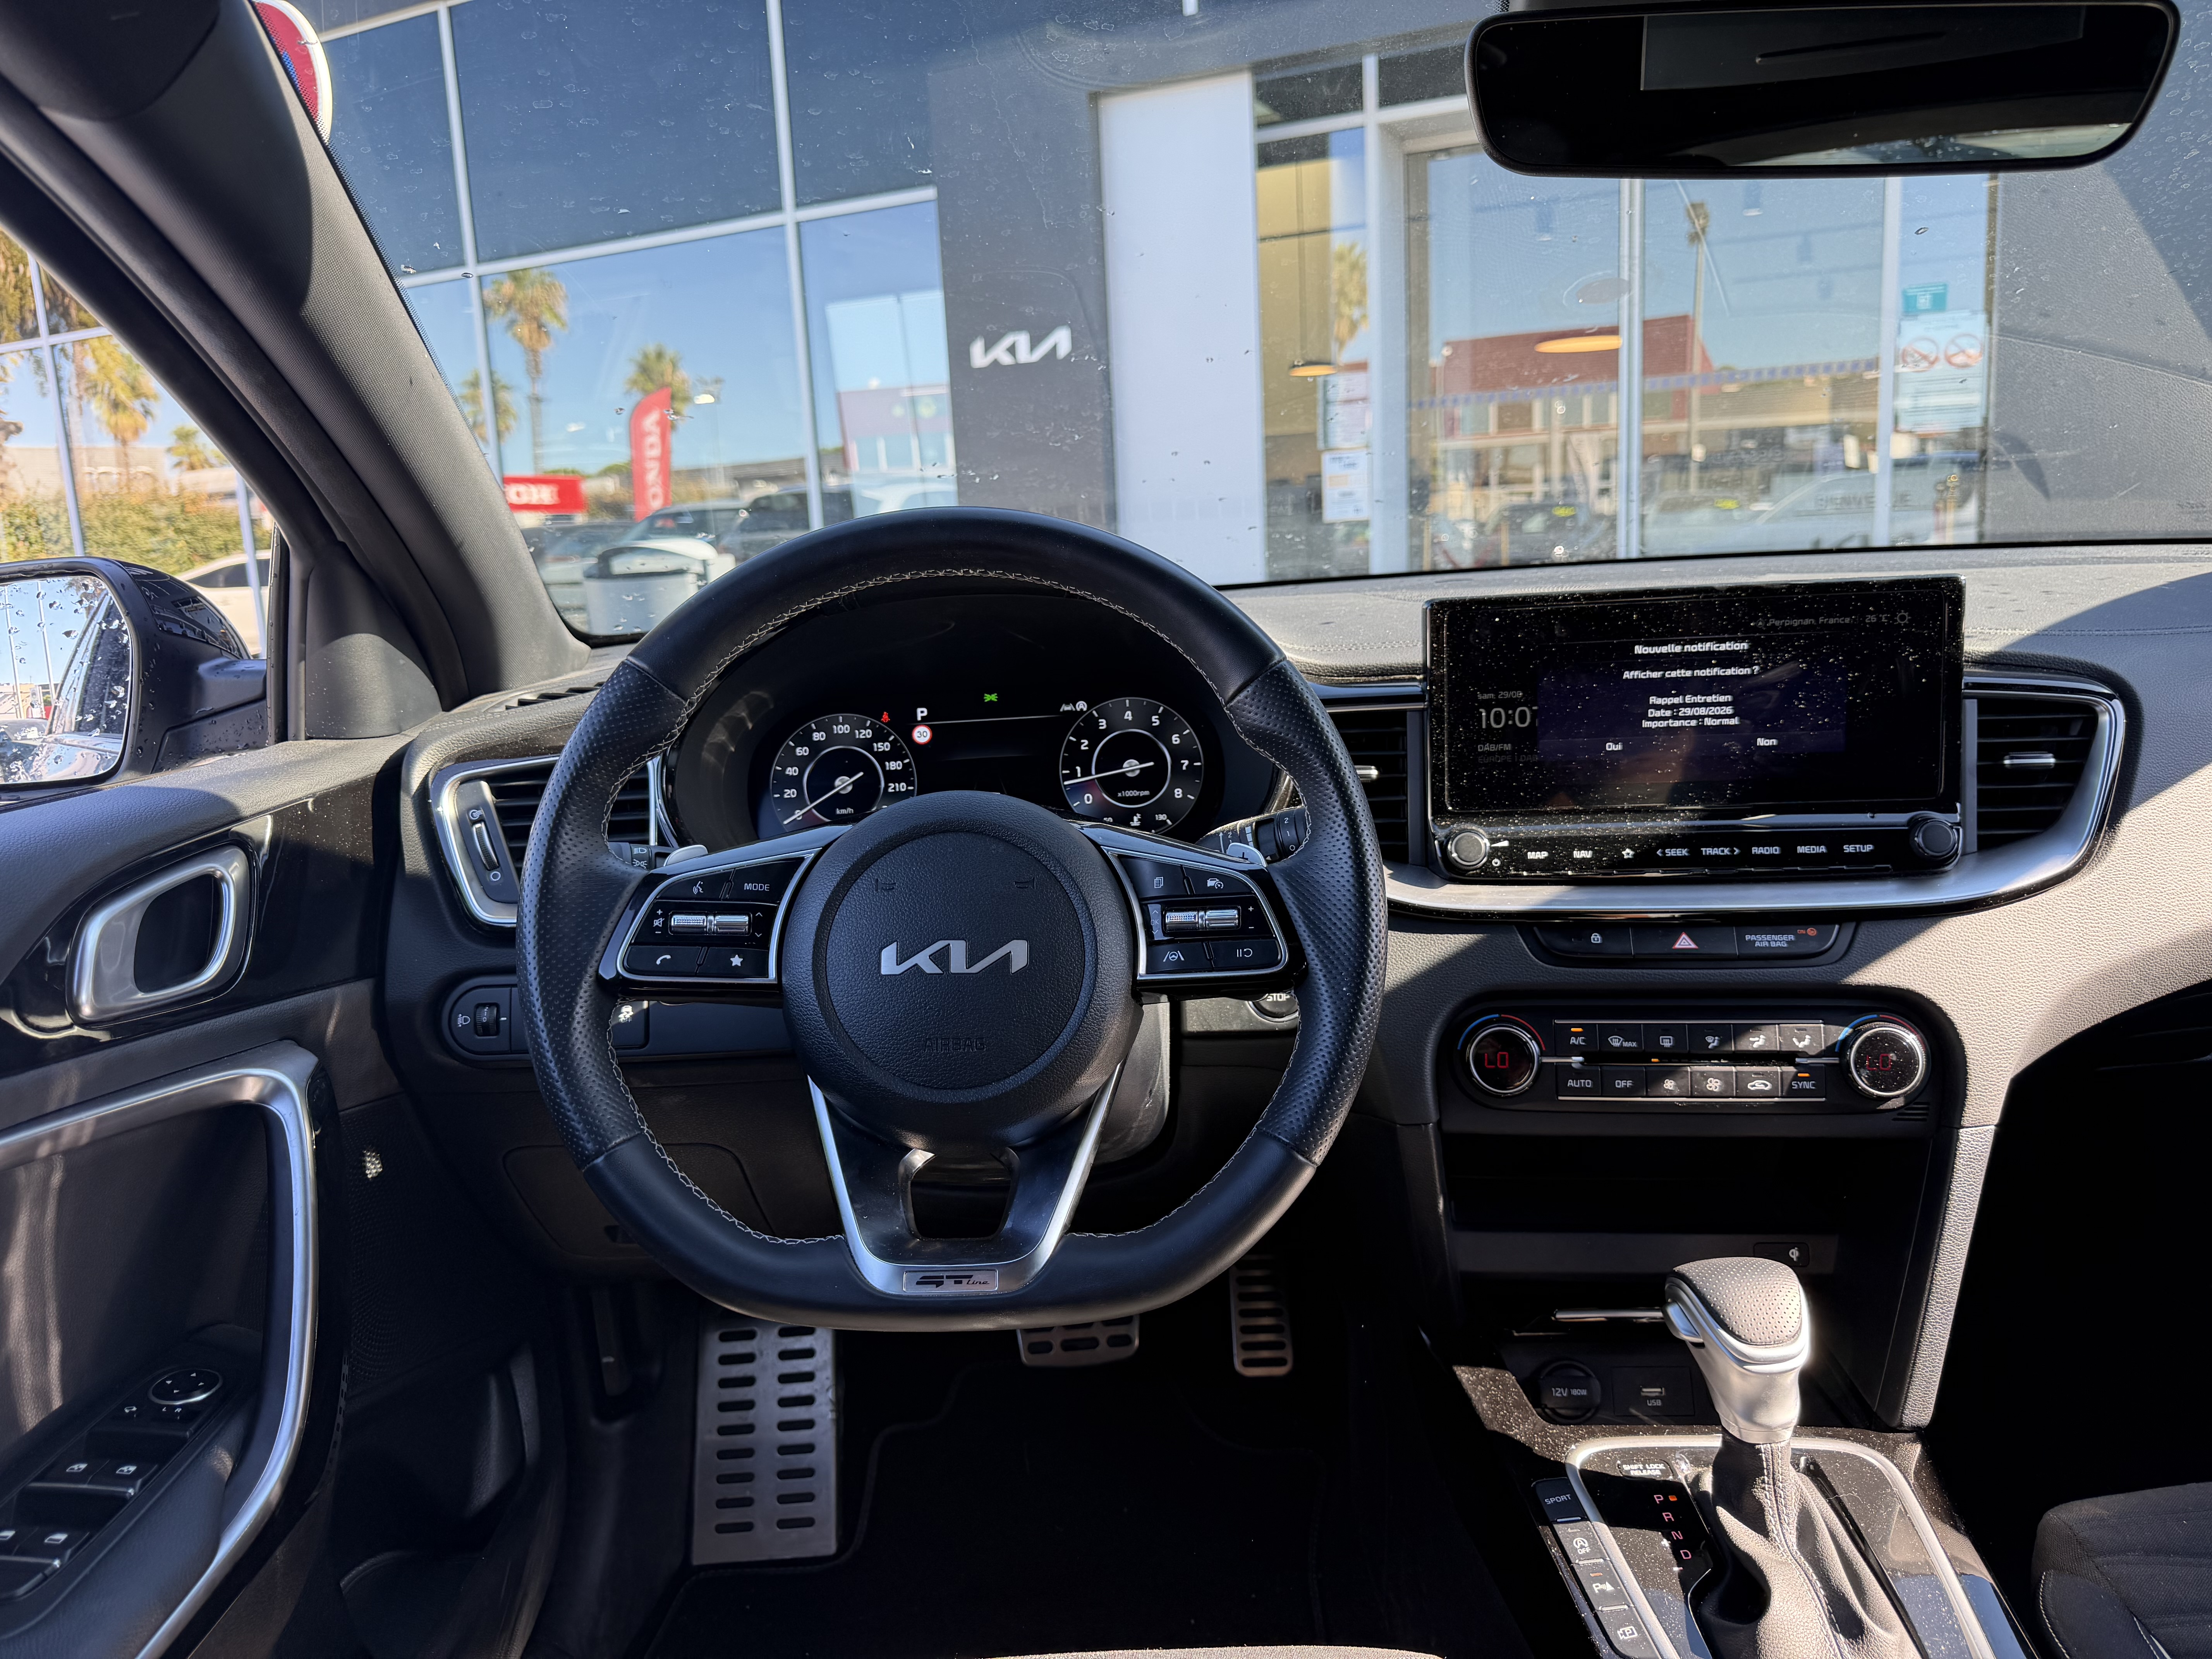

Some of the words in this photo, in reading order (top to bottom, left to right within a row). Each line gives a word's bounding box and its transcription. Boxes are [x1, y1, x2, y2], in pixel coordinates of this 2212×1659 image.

[970, 325, 1072, 368] KIA
[1635, 644, 1683, 654] Nouvelle
[1684, 641, 1750, 652] notification
[1623, 670, 1664, 679] Afficher
[1665, 668, 1693, 678] cette
[1694, 666, 1752, 677] notification
[1649, 696, 1684, 705] Rappel
[1685, 694, 1734, 704] Entretien
[916, 708, 928, 721] P
[1124, 711, 1133, 721] 4
[1648, 709, 1673, 717] Date
[1679, 706, 1735, 716] 29/08/2026
[1098, 719, 1107, 729] 3
[1151, 716, 1160, 726] 5
[1642, 719, 1698, 728] Importance
[1704, 716, 1741, 725] Normal
[833, 725, 850, 734] 100
[855, 729, 872, 738] 120
[812, 732, 826, 741] 80
[1171, 734, 1180, 744] 6
[1080, 739, 1089, 750] 2
[1606, 742, 1623, 750] Oui
[1757, 738, 1778, 746] Non
[795, 747, 809, 756] 60
[873, 742, 890, 752] 150
[885, 761, 903, 770] 180
[1180, 760, 1189, 770] 7
[785, 767, 799, 776] 40
[1075, 766, 1081, 777] 1
[888, 783, 907, 792] 210
[783, 789, 797, 798] 20
[1174, 788, 1183, 798] 8
[1084, 793, 1093, 804] 0
[1665, 848, 1690, 856] SEEK
[1752, 847, 1781, 855] RADIO
[1797, 845, 1827, 854] MEDIA
[1843, 845, 1874, 853] SETUP
[744, 883, 770, 891] MODE
[881, 939, 1029, 975] KIA
[1266, 993, 1290, 1001] STOP
[924, 1037, 986, 1053] AIRBAG
[1570, 1037, 1587, 1045] A/C
[1568, 1079, 1592, 1087] AUTO
[1791, 1081, 1816, 1089] SYNC
[1552, 1388, 1568, 1396] 12V
[1545, 1494, 1571, 1505] SPORT
[1654, 1494, 1664, 1504] P
[1662, 1512, 1674, 1522] R
[1671, 1531, 1683, 1540] N
[1680, 1550, 1692, 1559] D
